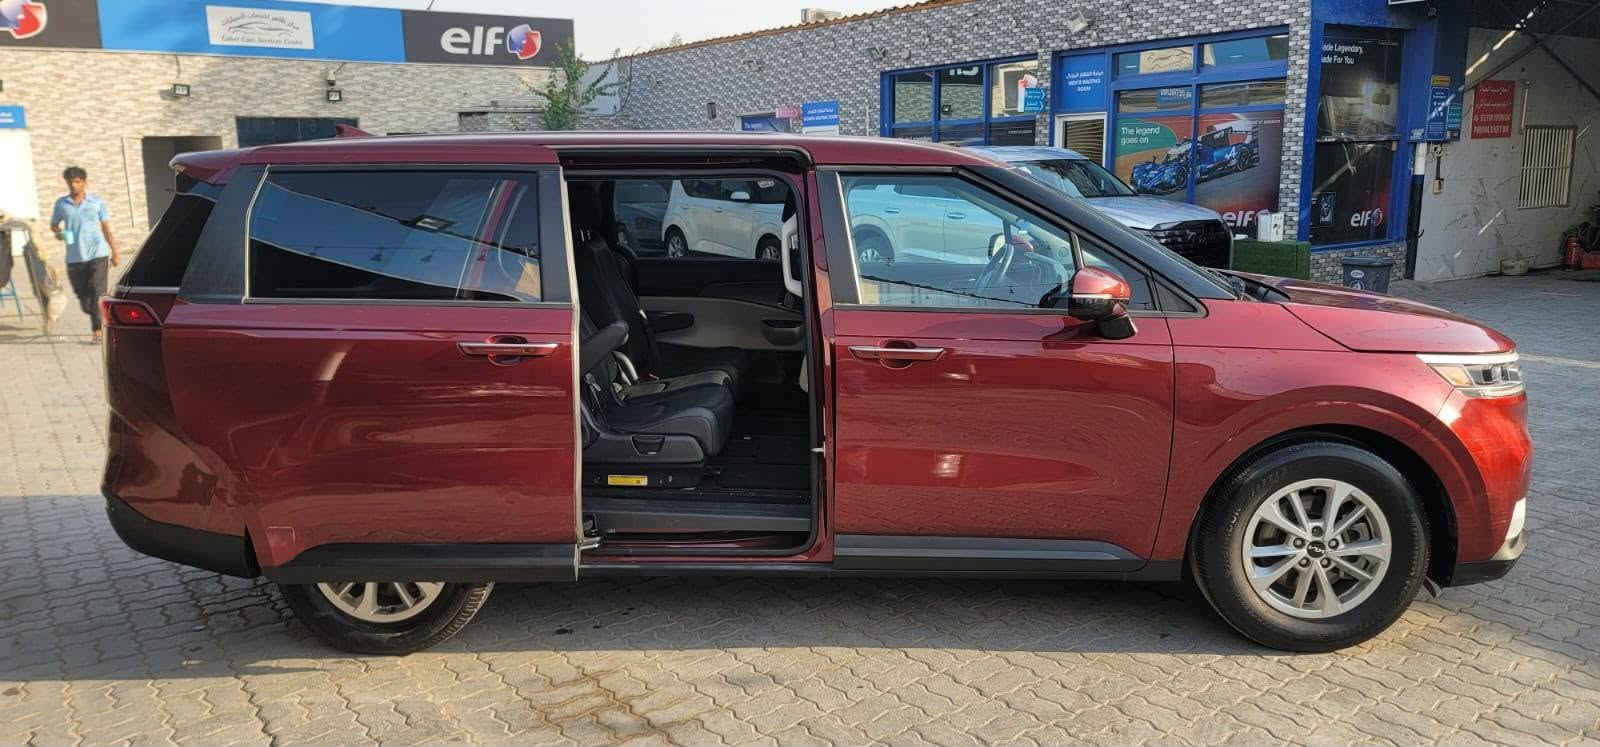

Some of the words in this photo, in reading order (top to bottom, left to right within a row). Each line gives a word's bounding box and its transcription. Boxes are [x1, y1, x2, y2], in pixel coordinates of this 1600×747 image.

[440, 26, 505, 56] elf
[1344, 55, 1355, 64] You
[1121, 127, 1135, 135] The
[1136, 126, 1160, 136] legend
[1222, 210, 1255, 227] elf
[1350, 211, 1372, 227] elf
